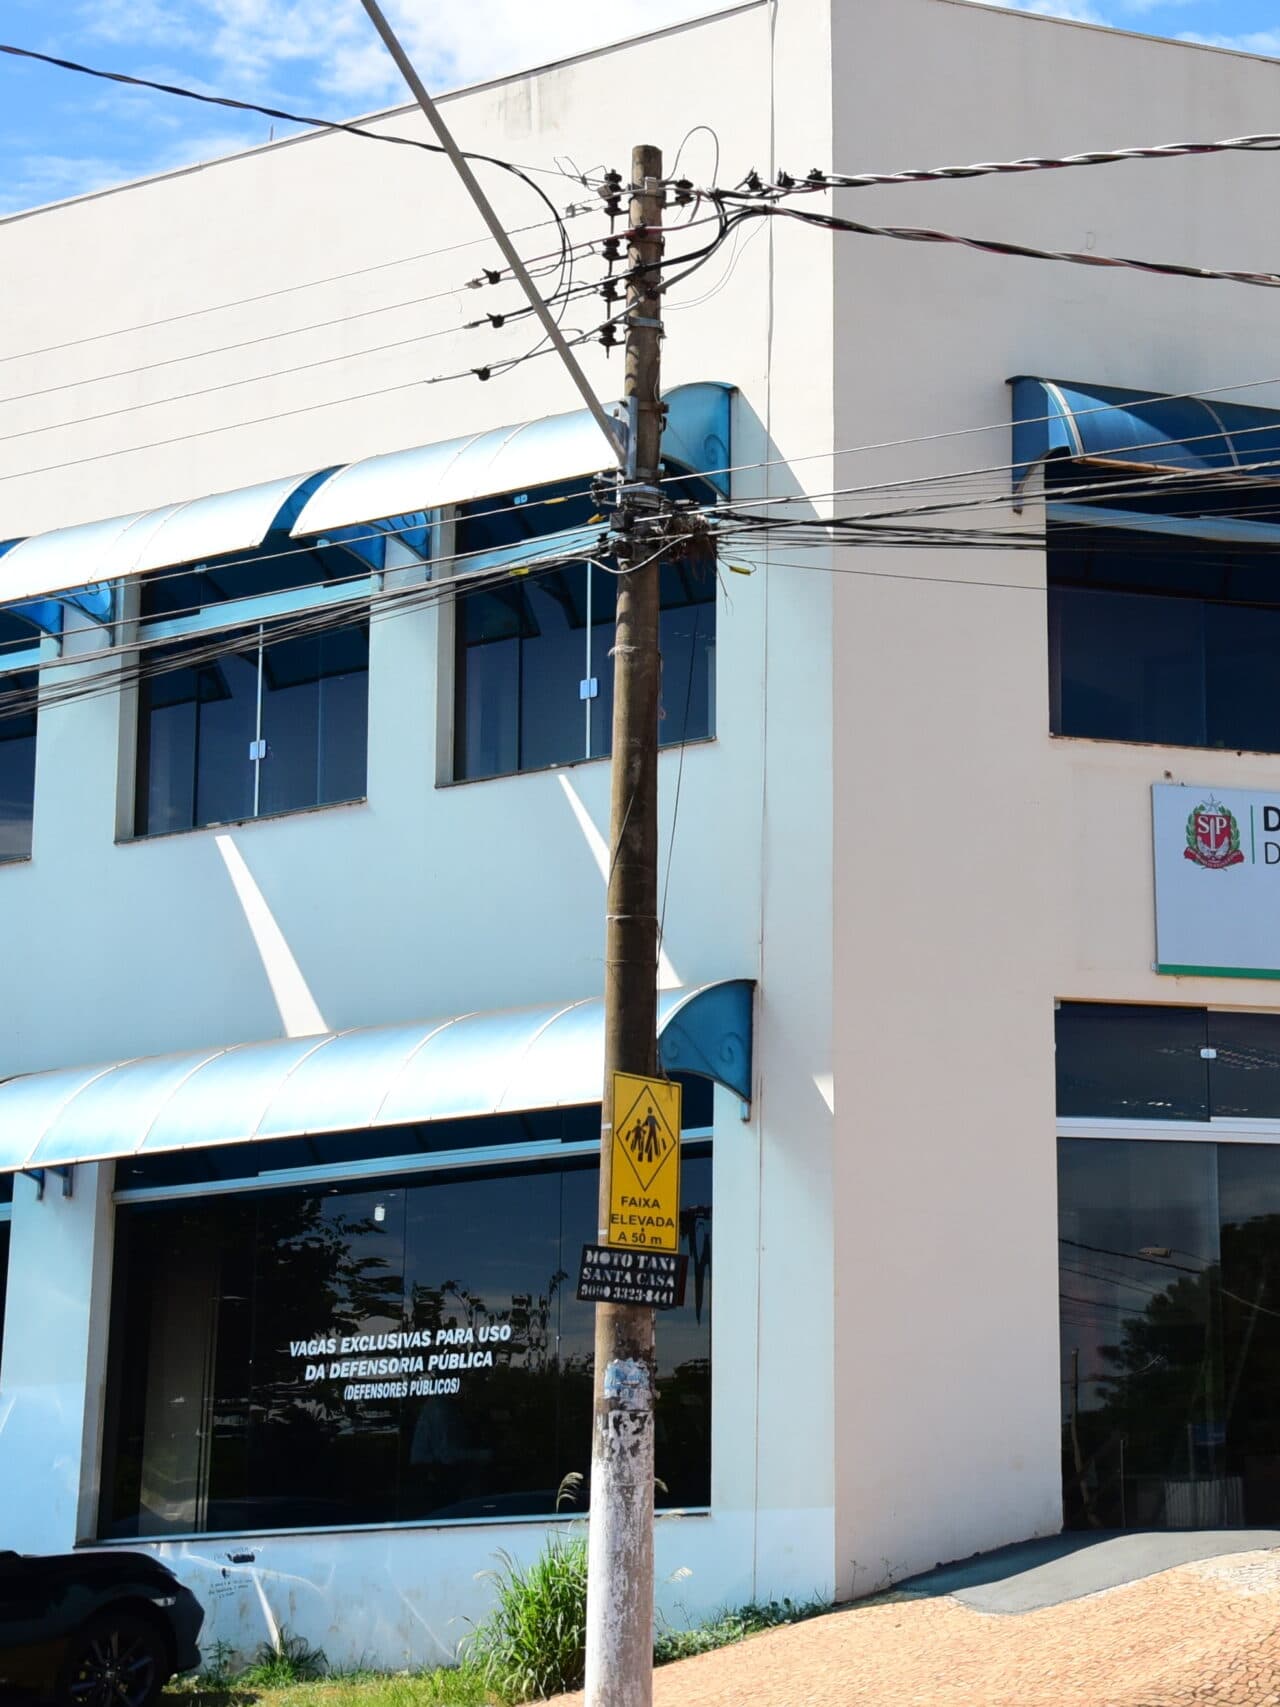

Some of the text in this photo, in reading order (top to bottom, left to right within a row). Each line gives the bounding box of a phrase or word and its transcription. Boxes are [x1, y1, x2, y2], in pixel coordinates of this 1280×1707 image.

[1197, 815, 1228, 835] SP
[621, 1195, 661, 1209] FAIXA
[611, 1213, 675, 1228] ELEVADA
[617, 1231, 662, 1245] A 50 m
[585, 1250, 676, 1271] MOTO TAXI
[582, 1267, 675, 1288] SANTA CASA
[289, 1324, 512, 1358] VAGAS EXCLUSIVAS PARA USO
[304, 1349, 494, 1381] DA DEFENSORIA PÚBLICA
[343, 1377, 461, 1400] (DEFENSORES PÚBLICOS)
